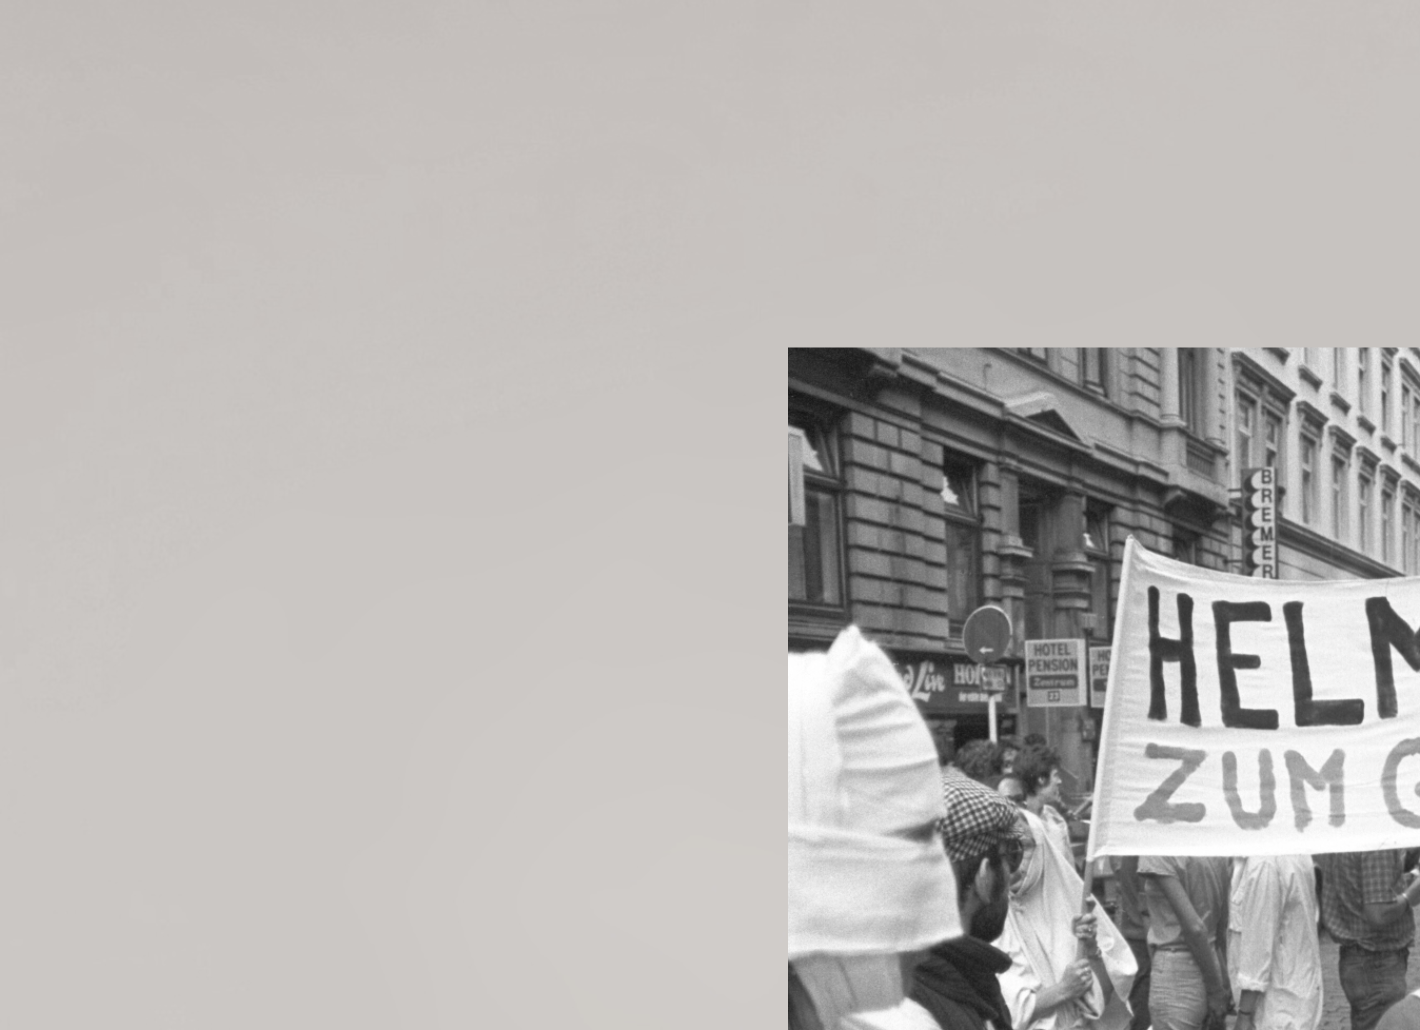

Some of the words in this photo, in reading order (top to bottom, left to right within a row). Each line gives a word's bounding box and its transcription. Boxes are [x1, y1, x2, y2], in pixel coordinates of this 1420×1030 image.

[1260, 469, 1274, 579] BREMER
[1028, 659, 1078, 673] PENSION
[1033, 643, 1071, 657] HOTEL
[1133, 742, 1346, 833] ZUM
